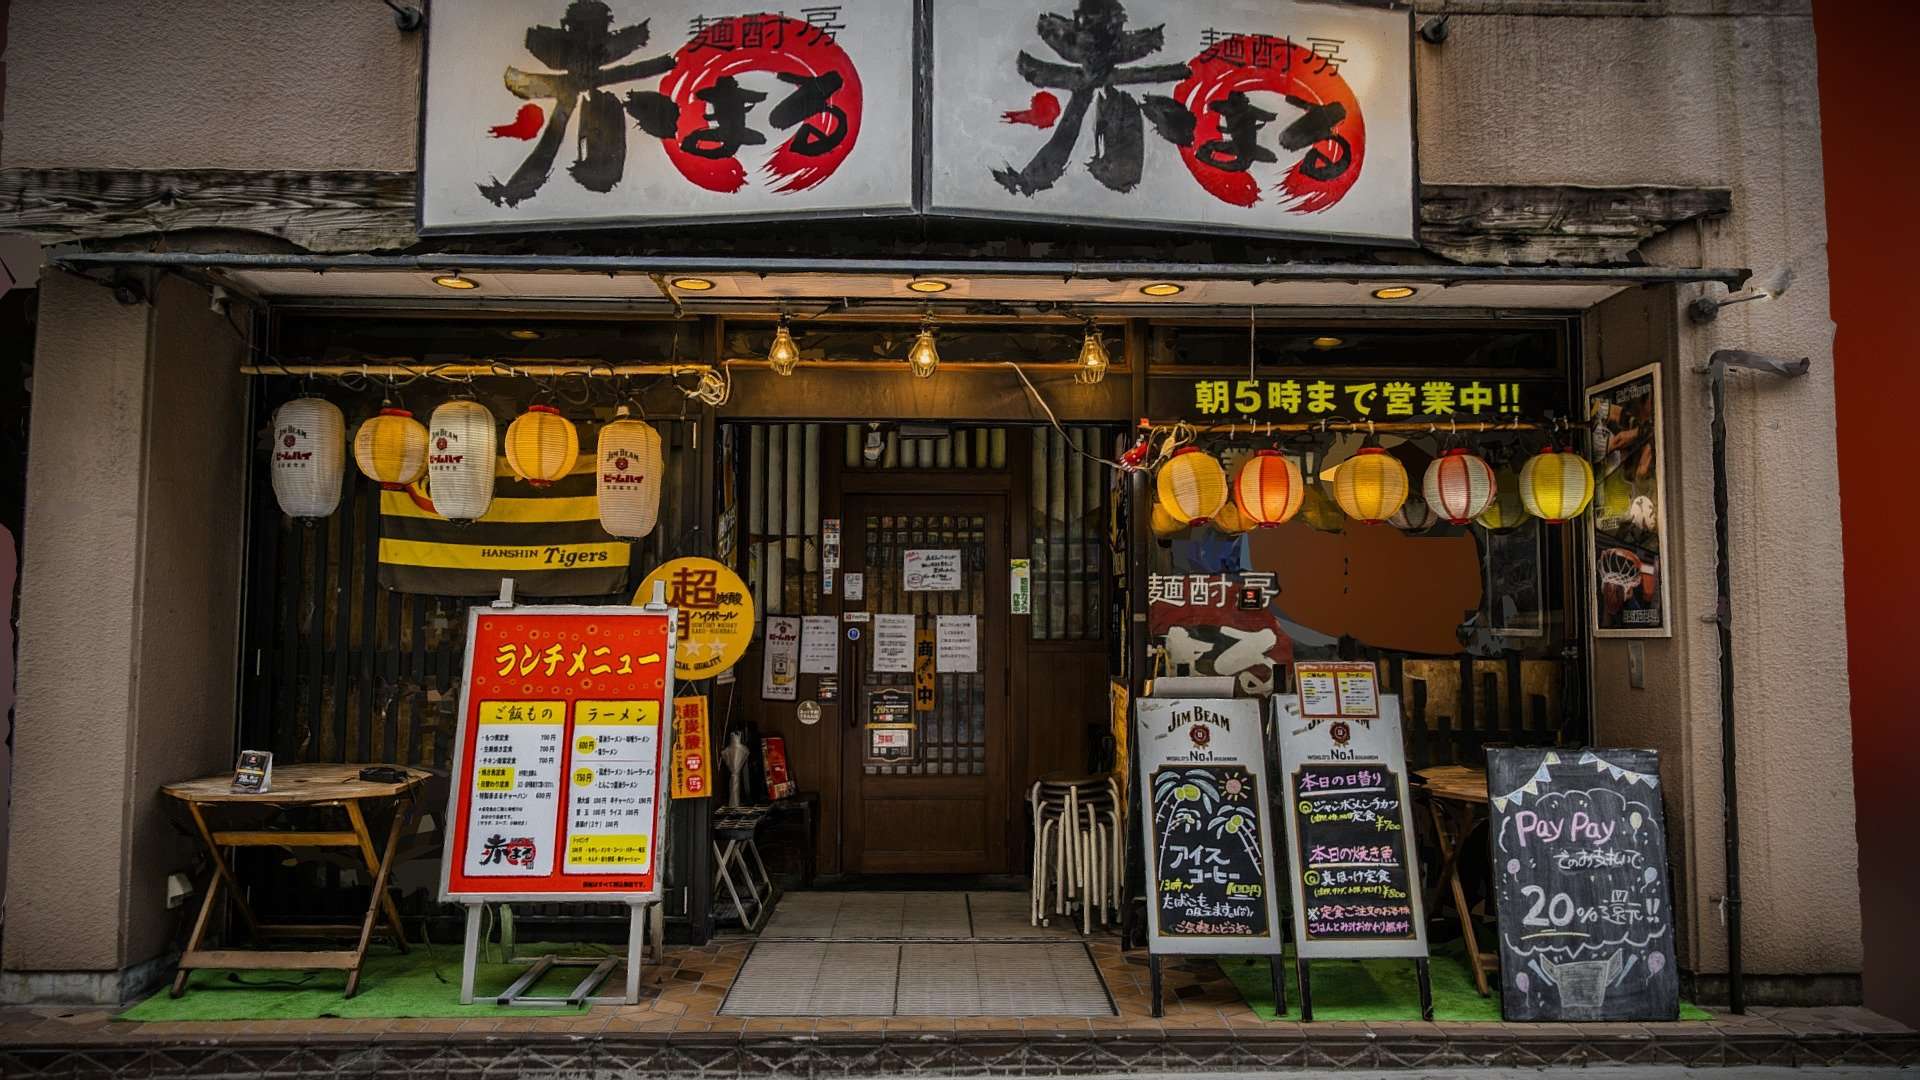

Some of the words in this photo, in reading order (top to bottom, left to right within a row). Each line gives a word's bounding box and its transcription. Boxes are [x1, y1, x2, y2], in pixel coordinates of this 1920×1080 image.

[620, 449, 639, 463] BEAM
[481, 549, 538, 558] HANSHIN
[544, 547, 608, 567] Tigers
[668, 567, 720, 609] 超
[691, 611, 738, 622] ハイボール
[495, 643, 661, 678] ランチメニュー
[694, 655, 722, 671] QUALITY
[496, 705, 553, 721] ご飯もの
[587, 707, 647, 722] ラーメン
[1168, 710, 1191, 732] JIM
[1194, 706, 1230, 732] BEAM
[1190, 750, 1213, 762] No.1
[1330, 749, 1354, 761] No.1
[1299, 769, 1382, 791] 本日の日替り
[1313, 797, 1399, 812] ジャンボメンチカツ
[1375, 814, 1401, 832] ¥700
[1515, 811, 1564, 847] Pay
[1570, 811, 1616, 846] Pay
[1169, 844, 1231, 869] アイス
[1309, 844, 1397, 864] 本日の焼き魚
[1188, 866, 1241, 884] コーヒー
[1321, 869, 1392, 887] 真ほっけ定食
[1163, 892, 1210, 910] たばこも
